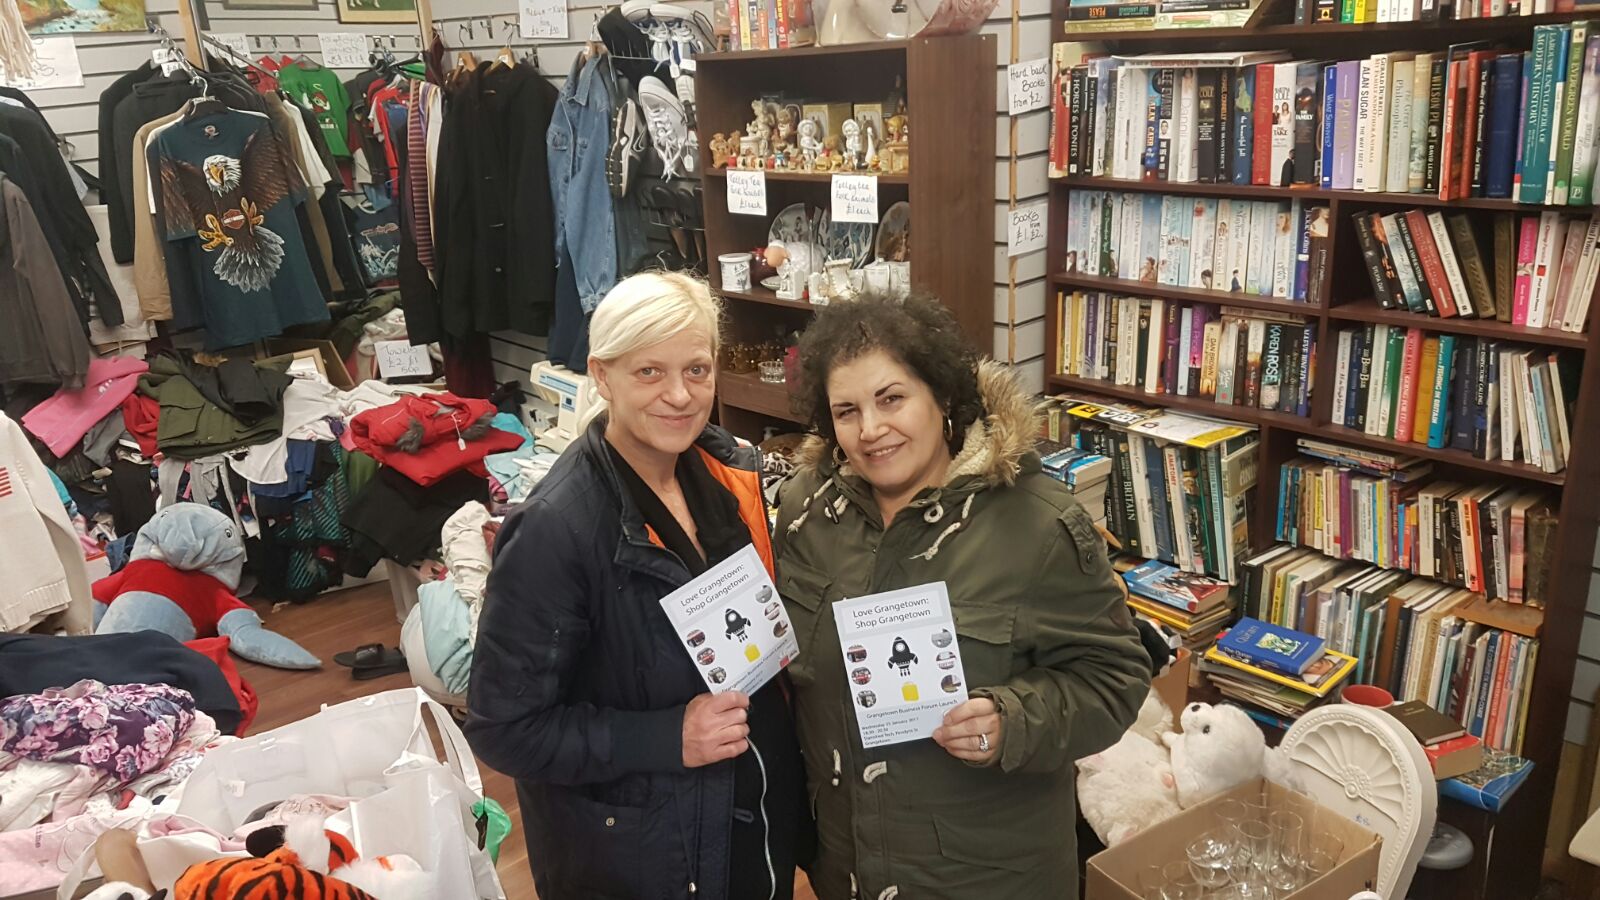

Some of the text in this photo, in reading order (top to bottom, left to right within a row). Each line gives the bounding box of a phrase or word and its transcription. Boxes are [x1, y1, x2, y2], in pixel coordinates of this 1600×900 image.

[1089, 8, 1106, 17] PEASE
[1011, 64, 1047, 80] Hard back
[1361, 66, 1370, 88] ALAN
[1529, 33, 1545, 126] MODERN HISTORY
[1161, 69, 1172, 118] LEE EVANS
[1430, 75, 1442, 110] WILSON
[1478, 81, 1486, 99] Reality
[1539, 32, 1556, 143] LAROUSSE ENCYCLOPEDIA OF
[1562, 48, 1581, 150] THE EVERGREEN WORLD
[1014, 94, 1028, 108] from
[1147, 102, 1156, 121] ALAN
[1360, 91, 1369, 119] SUGAR
[1392, 79, 1404, 140] Philosophers
[1403, 104, 1412, 128] Great
[1477, 115, 1485, 142] Paranormal
[1583, 236, 1594, 257] Power
[1371, 265, 1385, 293] SYLVIA DAY
[1265, 325, 1282, 382] KAREN ROSE
[1300, 354, 1309, 382] BINCHY
[1435, 365, 1444, 390] FISHING
[1402, 375, 1410, 398] GOING
[1431, 399, 1440, 424] BRITAIN
[1168, 453, 1177, 487] ANATOMY
[1123, 481, 1136, 521] BRITAIN
[681, 563, 745, 607] Love Grangetown:
[686, 573, 749, 616] Shop Grangetown
[852, 596, 929, 619] Love Grangetown:
[855, 608, 931, 630] Shop Grangetown
[1480, 682, 1488, 701] PAINTING
[867, 710, 898, 719] Grangetown
[939, 699, 957, 707] Launch
[1477, 701, 1485, 718] COURSE
[862, 722, 885, 730] Wednesday
